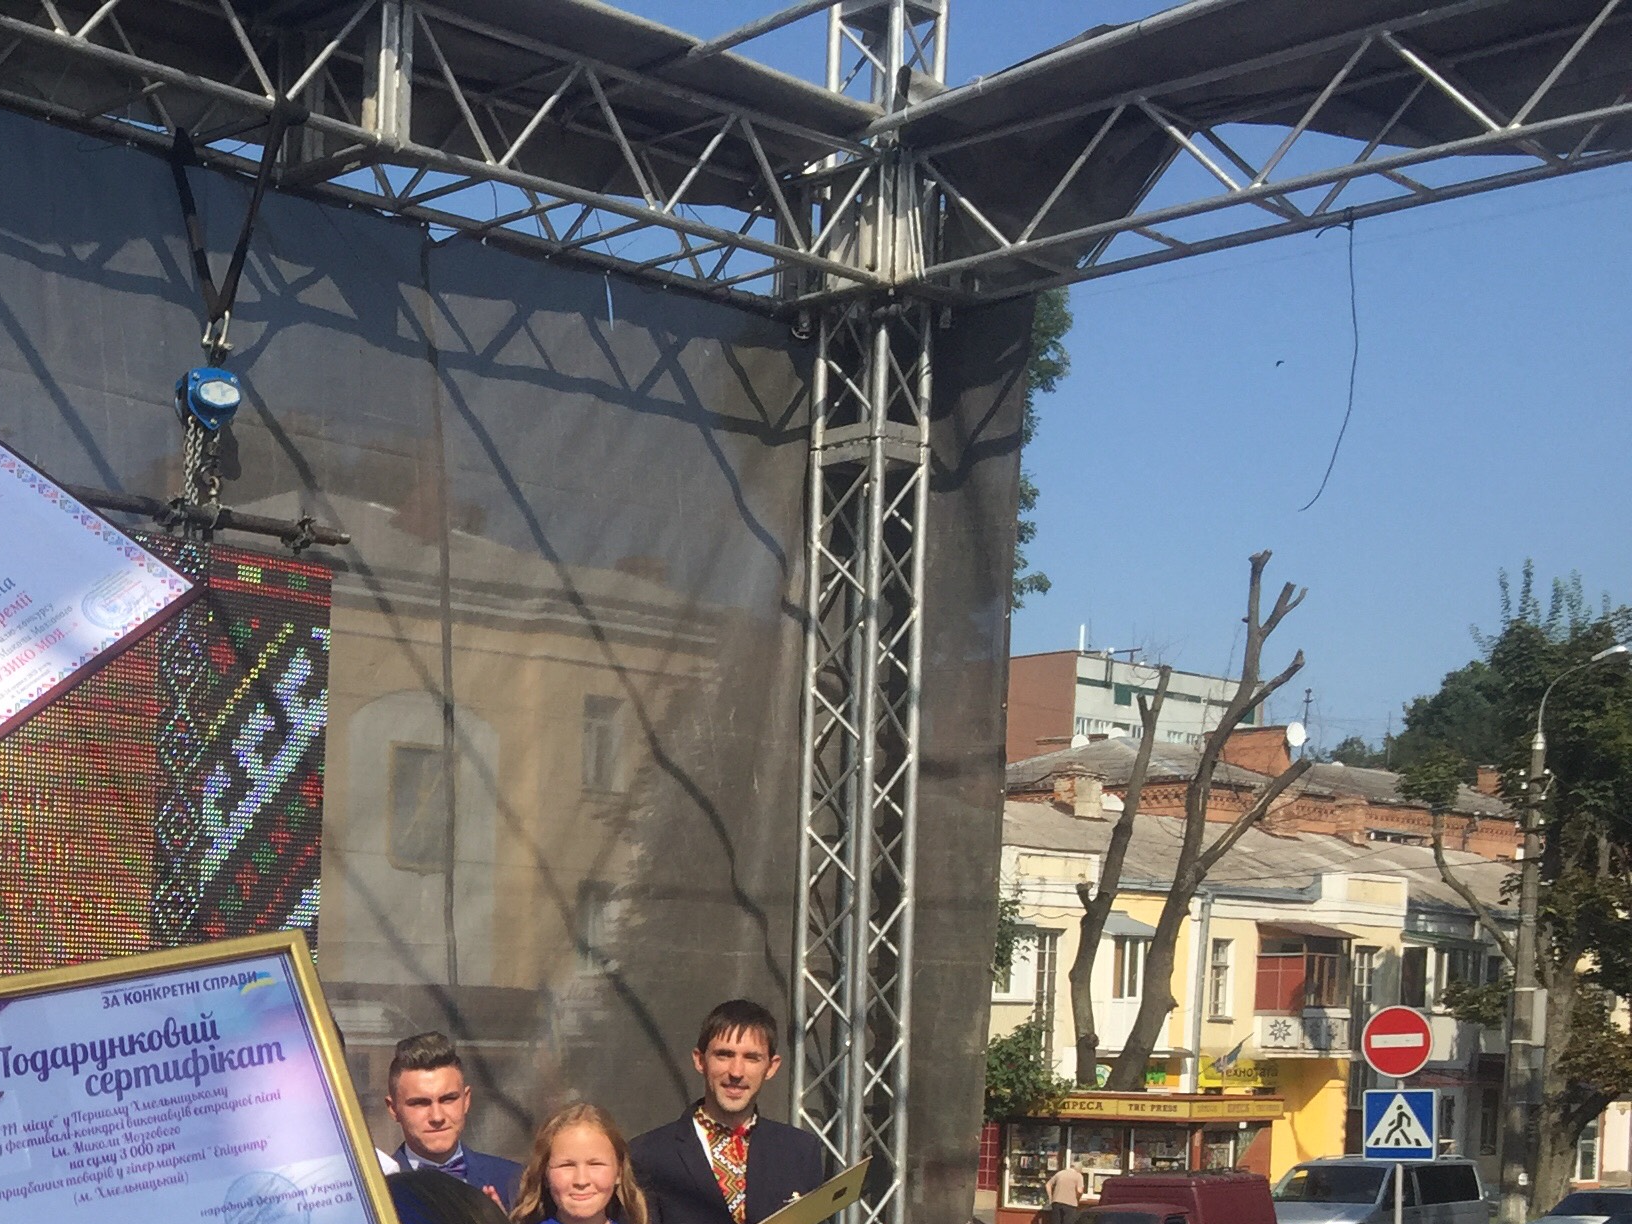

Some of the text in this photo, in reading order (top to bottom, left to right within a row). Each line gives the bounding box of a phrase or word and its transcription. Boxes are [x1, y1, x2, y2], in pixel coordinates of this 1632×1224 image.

[101, 994, 120, 1009] ЗА
[123, 980, 200, 1005] КОНКРЕТНІ
[202, 970, 258, 991] СПРАВИ
[84, 1041, 286, 1101] сертифікат
[62, 1116, 70, 1129] у
[70, 1105, 129, 1124] Першому
[130, 1086, 228, 1111] Хмельницькому
[126, 1105, 191, 1128] виконавців
[254, 1089, 281, 1103] пісні
[1062, 1101, 1104, 1111] ПРЕСА
[1150, 1104, 1178, 1113] PRESS
[69, 1141, 175, 1169] на суму 3 000 грн
[65, 1166, 114, 1186] товарів
[116, 1167, 123, 1179] у
[255, 1187, 307, 1206] депутат
[310, 1179, 353, 1194] України
